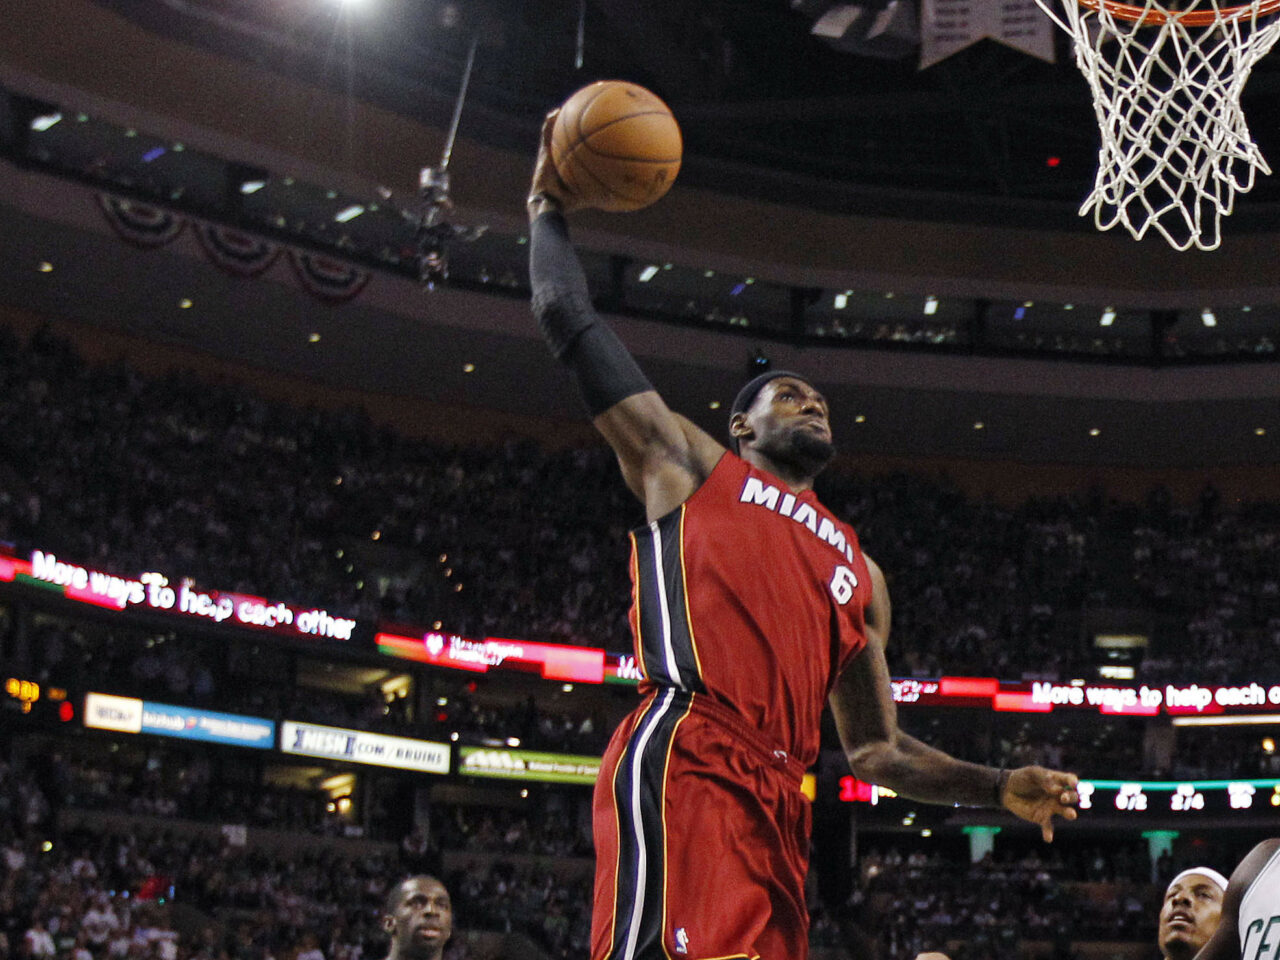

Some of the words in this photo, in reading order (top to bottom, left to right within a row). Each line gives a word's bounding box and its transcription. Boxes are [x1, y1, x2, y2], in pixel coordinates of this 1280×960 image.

[740, 477, 854, 564] MIAMI
[32, 550, 88, 589] More
[89, 570, 145, 608] ways
[297, 610, 356, 640] other
[830, 566, 858, 605] 6
[1032, 681, 1084, 704] More
[1086, 687, 1137, 712] ways
[1139, 685, 1163, 707] to
[1165, 684, 1213, 712] help
[1215, 682, 1266, 705] each
